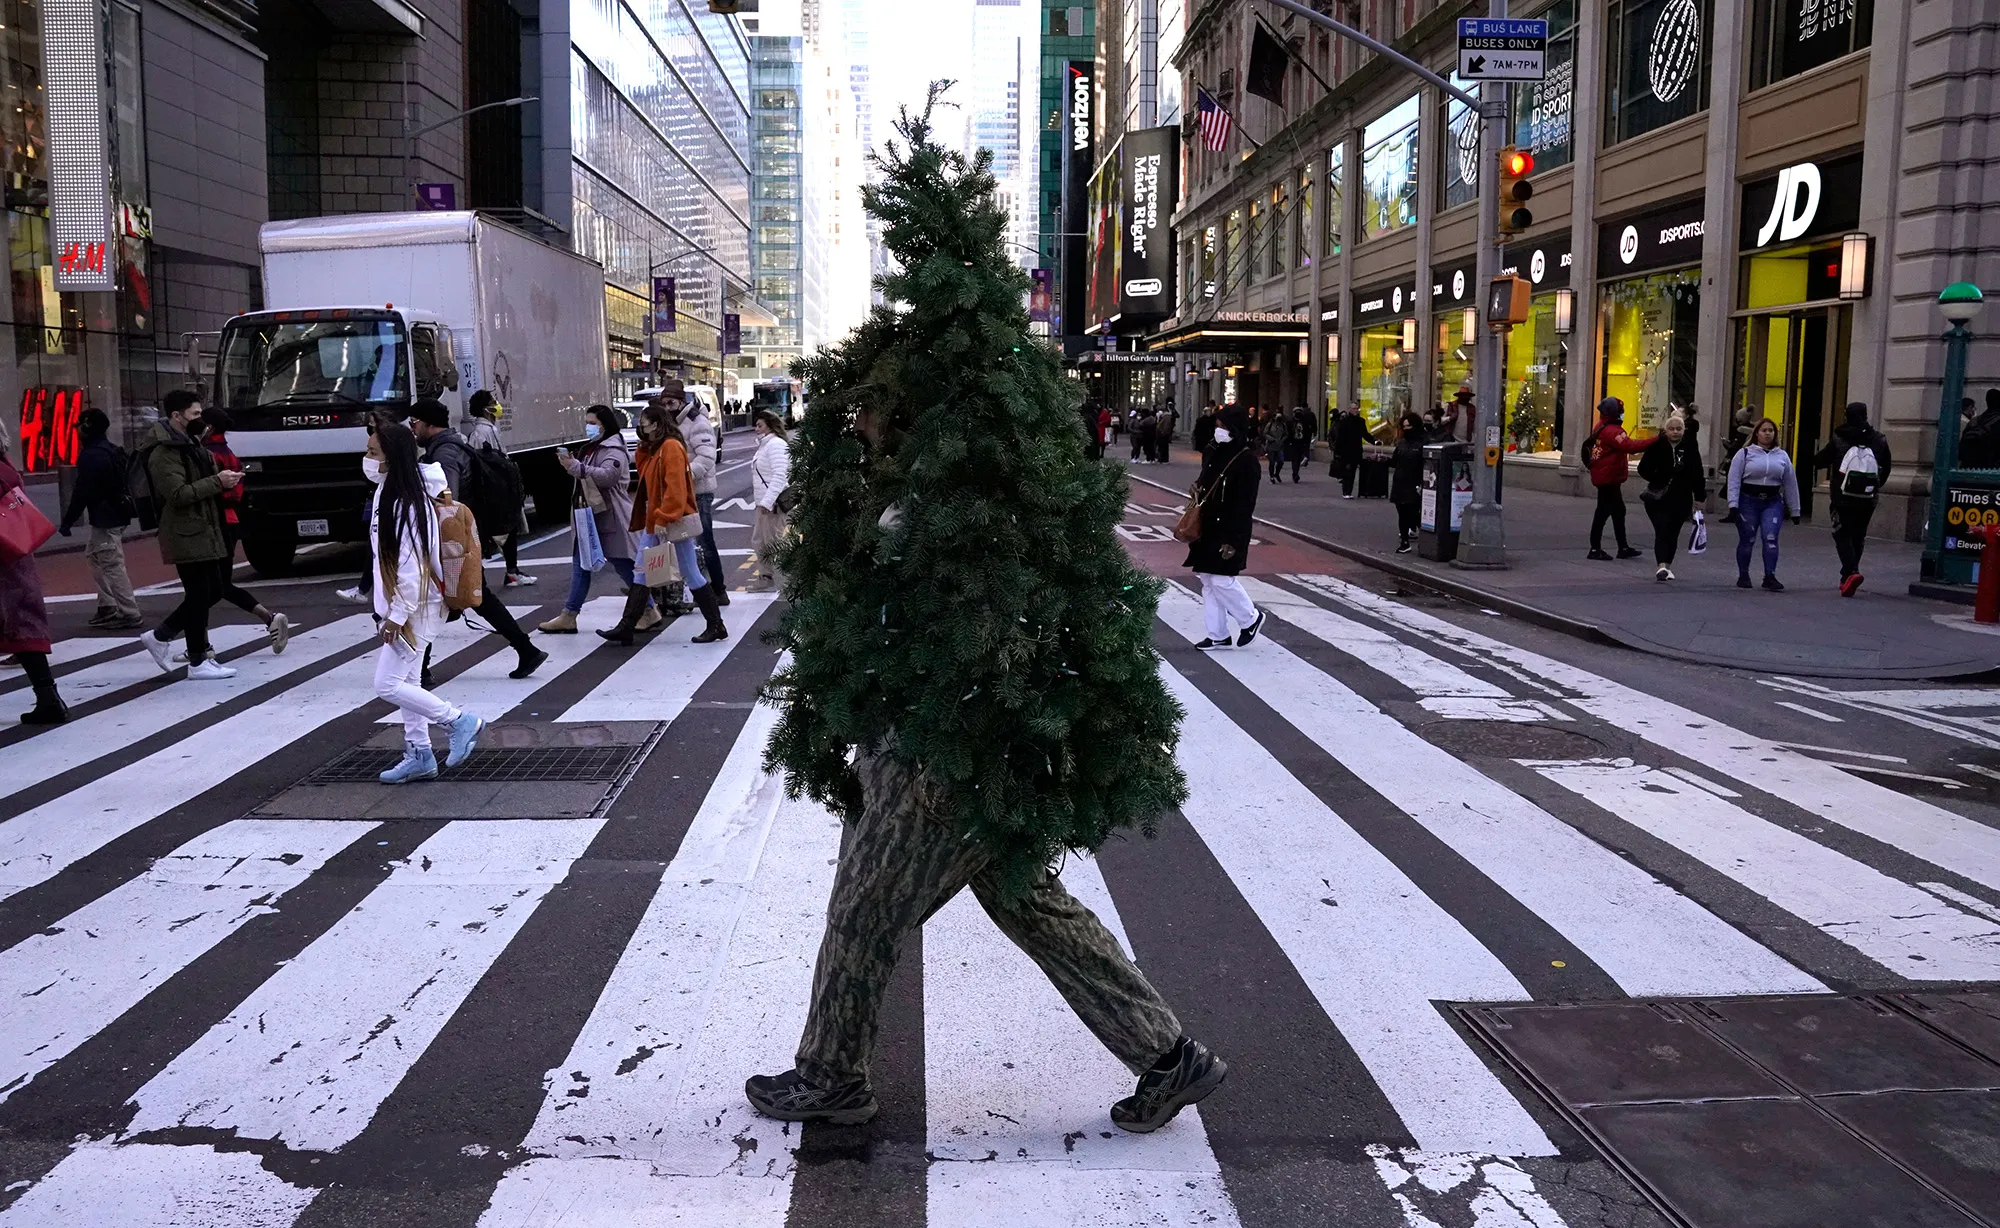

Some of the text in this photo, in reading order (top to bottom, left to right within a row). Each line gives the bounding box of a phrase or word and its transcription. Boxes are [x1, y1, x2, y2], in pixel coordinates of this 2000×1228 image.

[1483, 23, 1540, 34] BUS LANE
[1465, 38, 1539, 49] BUSES ONLY
[1492, 60, 1538, 70] 7AM-7PM
[1070, 76, 1089, 151] verizon
[1530, 107, 1541, 127] JD
[1134, 156, 1148, 203] Made
[1145, 154, 1161, 229] Espresso
[1757, 162, 1821, 248] JD
[58, 241, 106, 274] H&M
[1217, 311, 1310, 322] KNICKERBOCKER
[1130, 354, 1159, 362] Garden
[1160, 355, 1174, 363] Inn
[282, 415, 331, 426] ISUZU
[20, 388, 84, 473] H&M
[1950, 490, 1990, 505] Times
